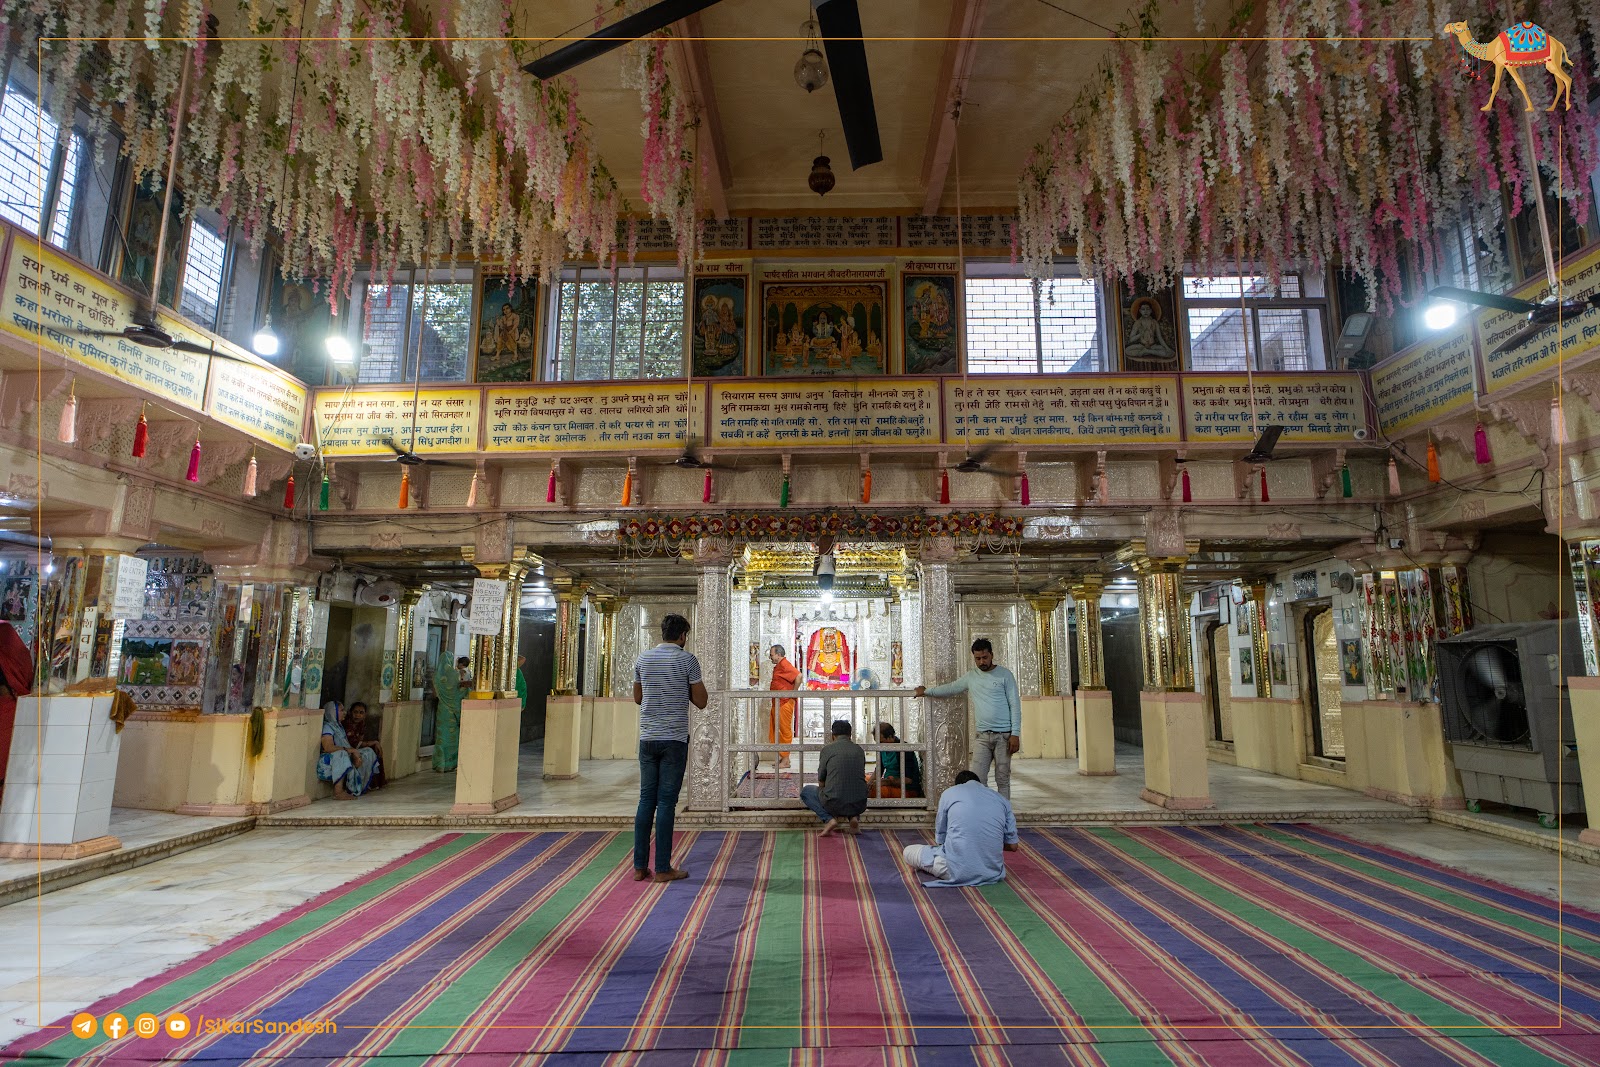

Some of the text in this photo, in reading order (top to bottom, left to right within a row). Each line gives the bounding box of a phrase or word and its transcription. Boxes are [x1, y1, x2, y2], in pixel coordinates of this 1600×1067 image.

[725, 263, 743, 271] सीता
[50, 270, 70, 286] धर्म
[73, 281, 86, 295] का
[92, 291, 108, 308] मूल
[55, 290, 74, 307] दया
